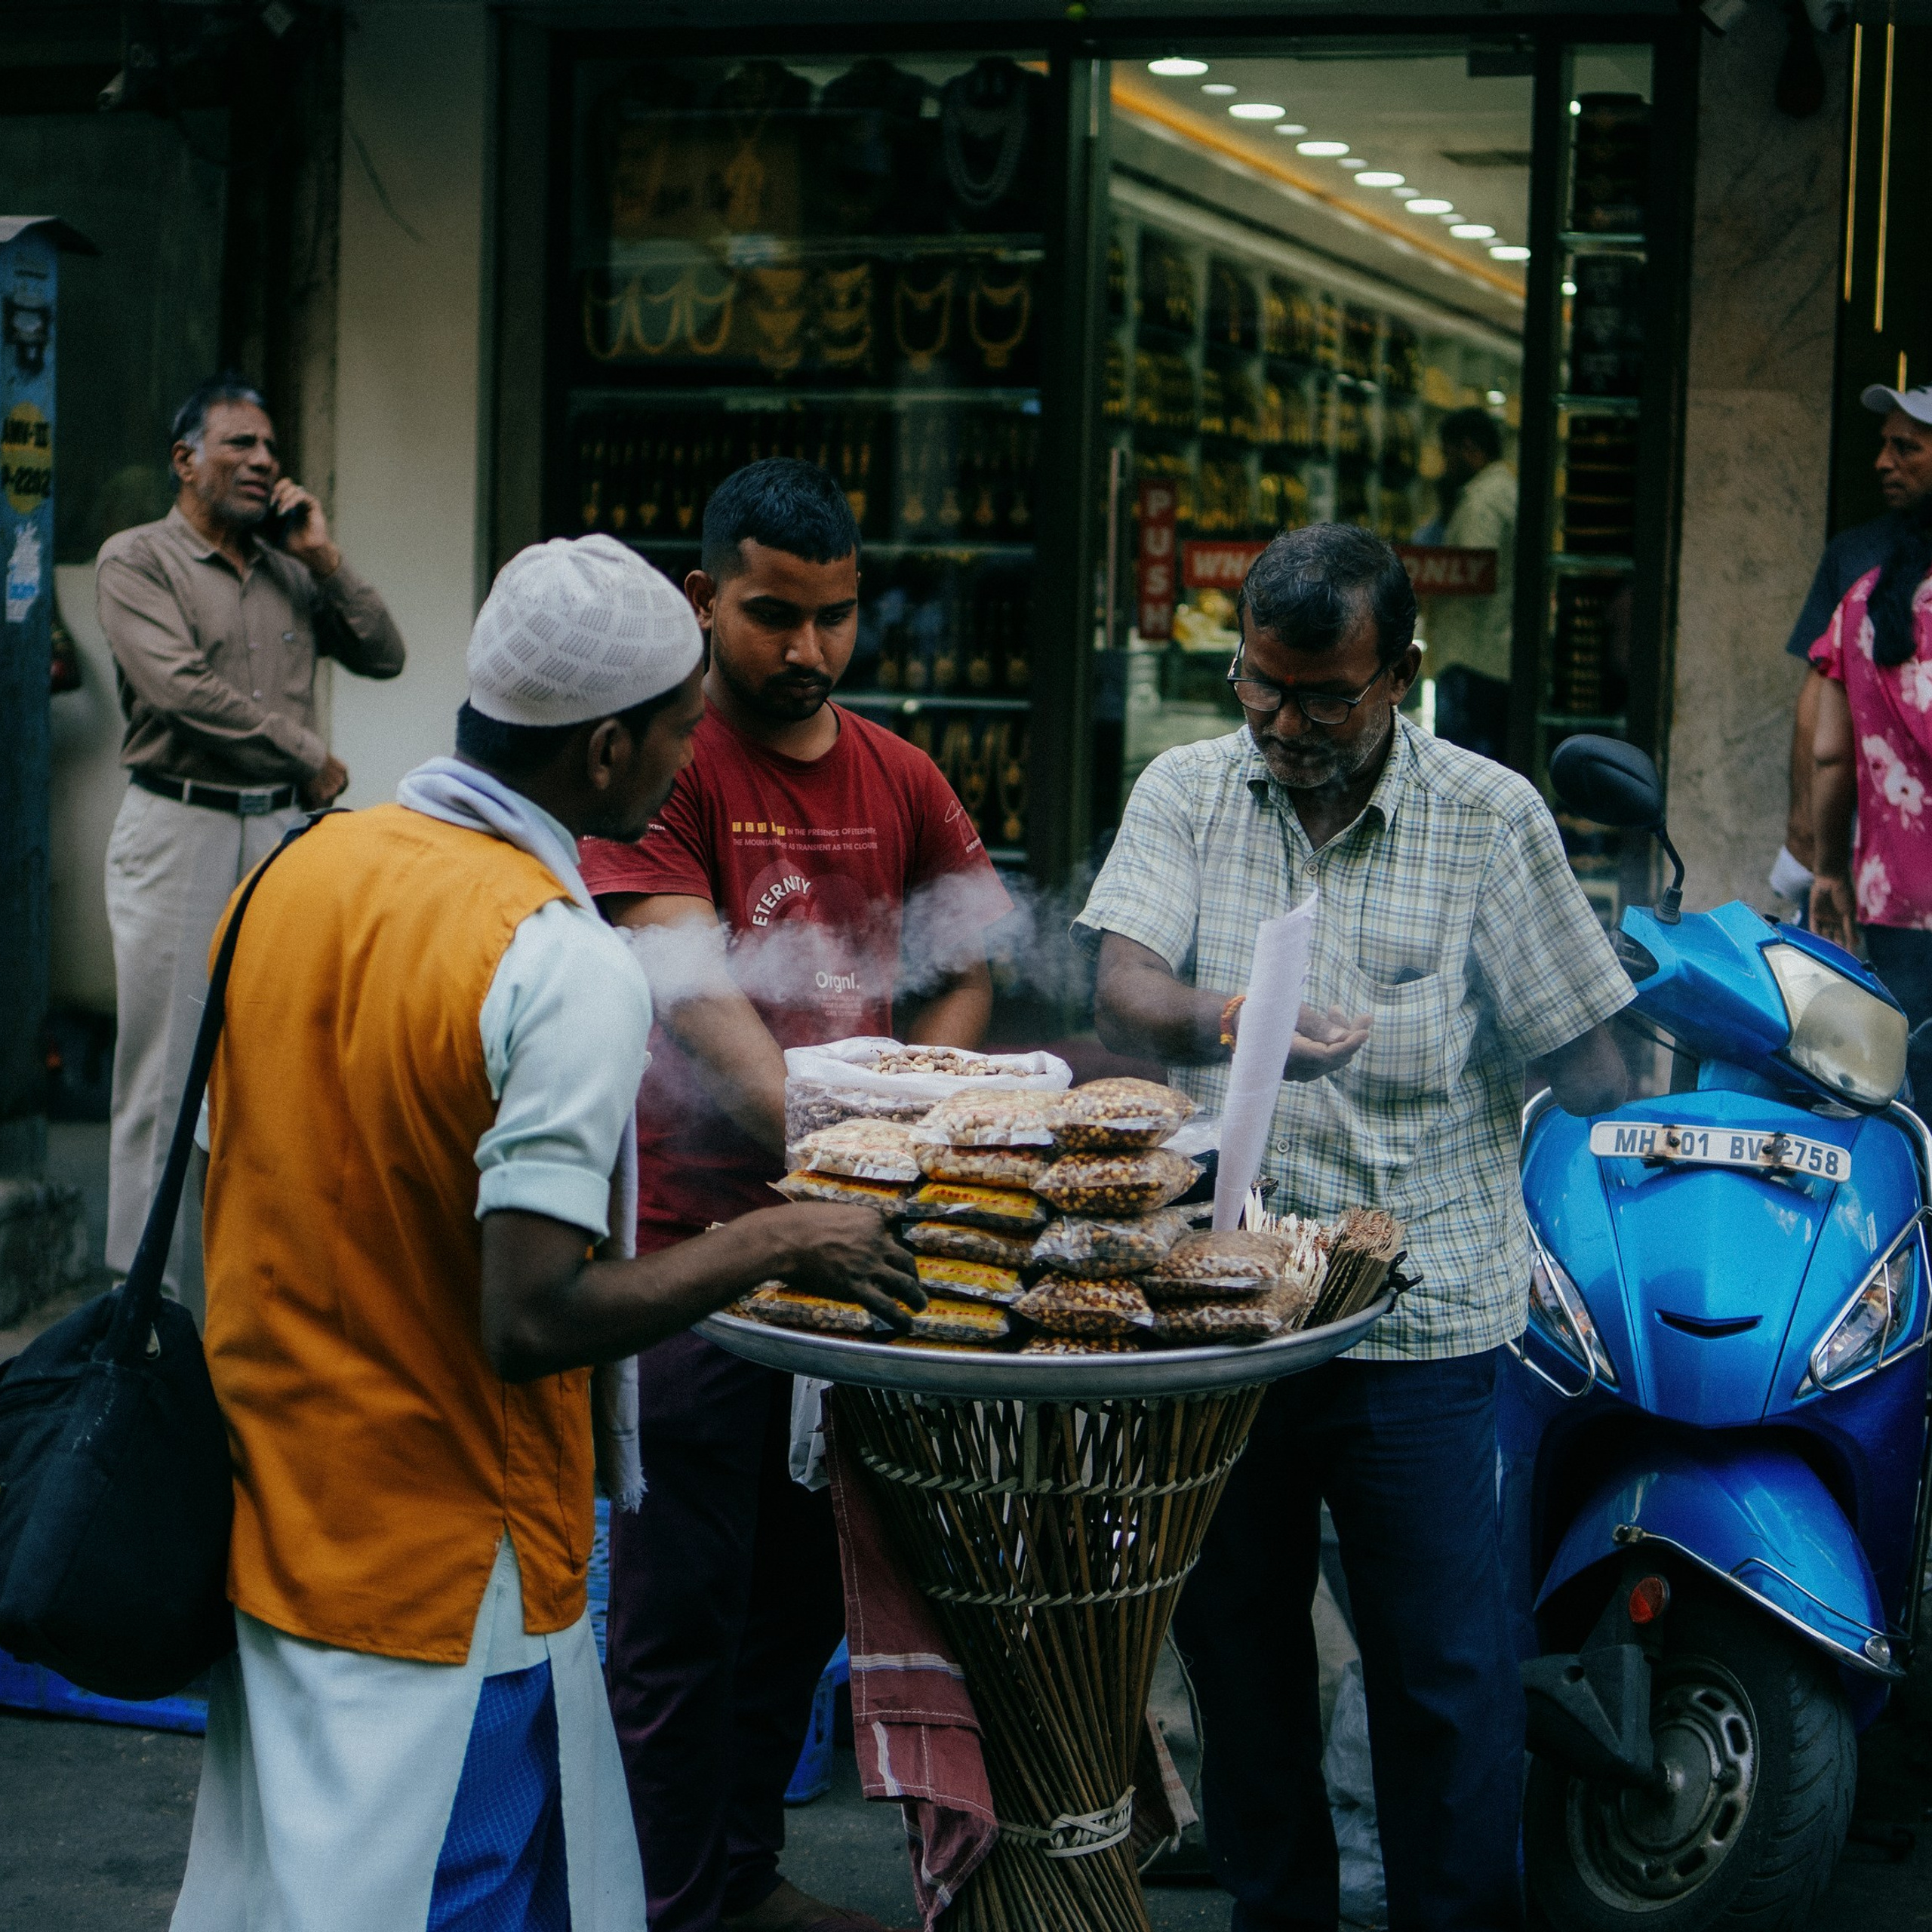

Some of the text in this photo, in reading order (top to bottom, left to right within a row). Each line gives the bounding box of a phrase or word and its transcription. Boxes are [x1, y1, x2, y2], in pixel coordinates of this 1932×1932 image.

[1143, 489, 1173, 633] PUSH
[1402, 555, 1487, 586] ONLY
[795, 828, 806, 836] THE
[808, 828, 840, 837] PRESENCE
[815, 971, 860, 993] Orgnl.
[1614, 1128, 1657, 1153] MH
[1680, 1131, 1710, 1158] 01
[1729, 1136, 1764, 1161] BV
